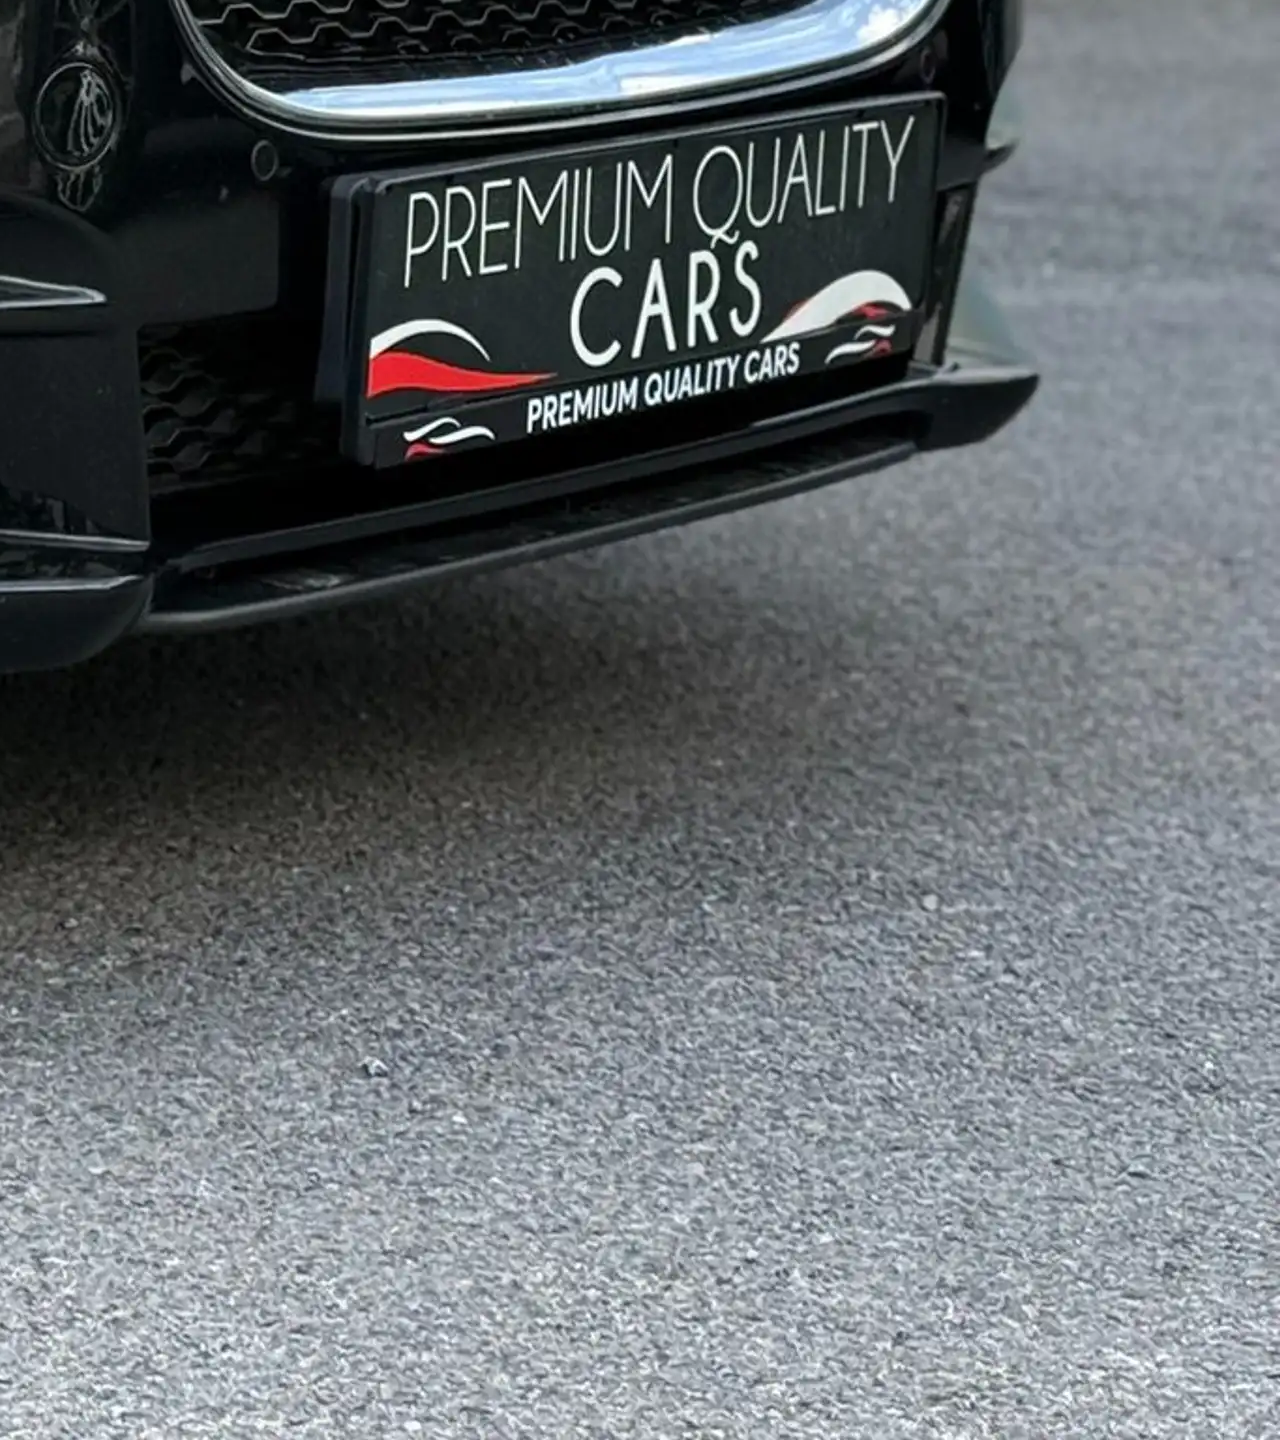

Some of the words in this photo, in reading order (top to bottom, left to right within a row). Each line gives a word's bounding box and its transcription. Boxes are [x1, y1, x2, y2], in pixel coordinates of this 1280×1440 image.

[403, 153, 673, 288] PREMIUM
[692, 114, 915, 250] QUALITY
[569, 239, 762, 368] CARS
[526, 375, 639, 434] PREMIUM
[643, 354, 741, 407] QUALITY
[743, 341, 801, 384] CARS
